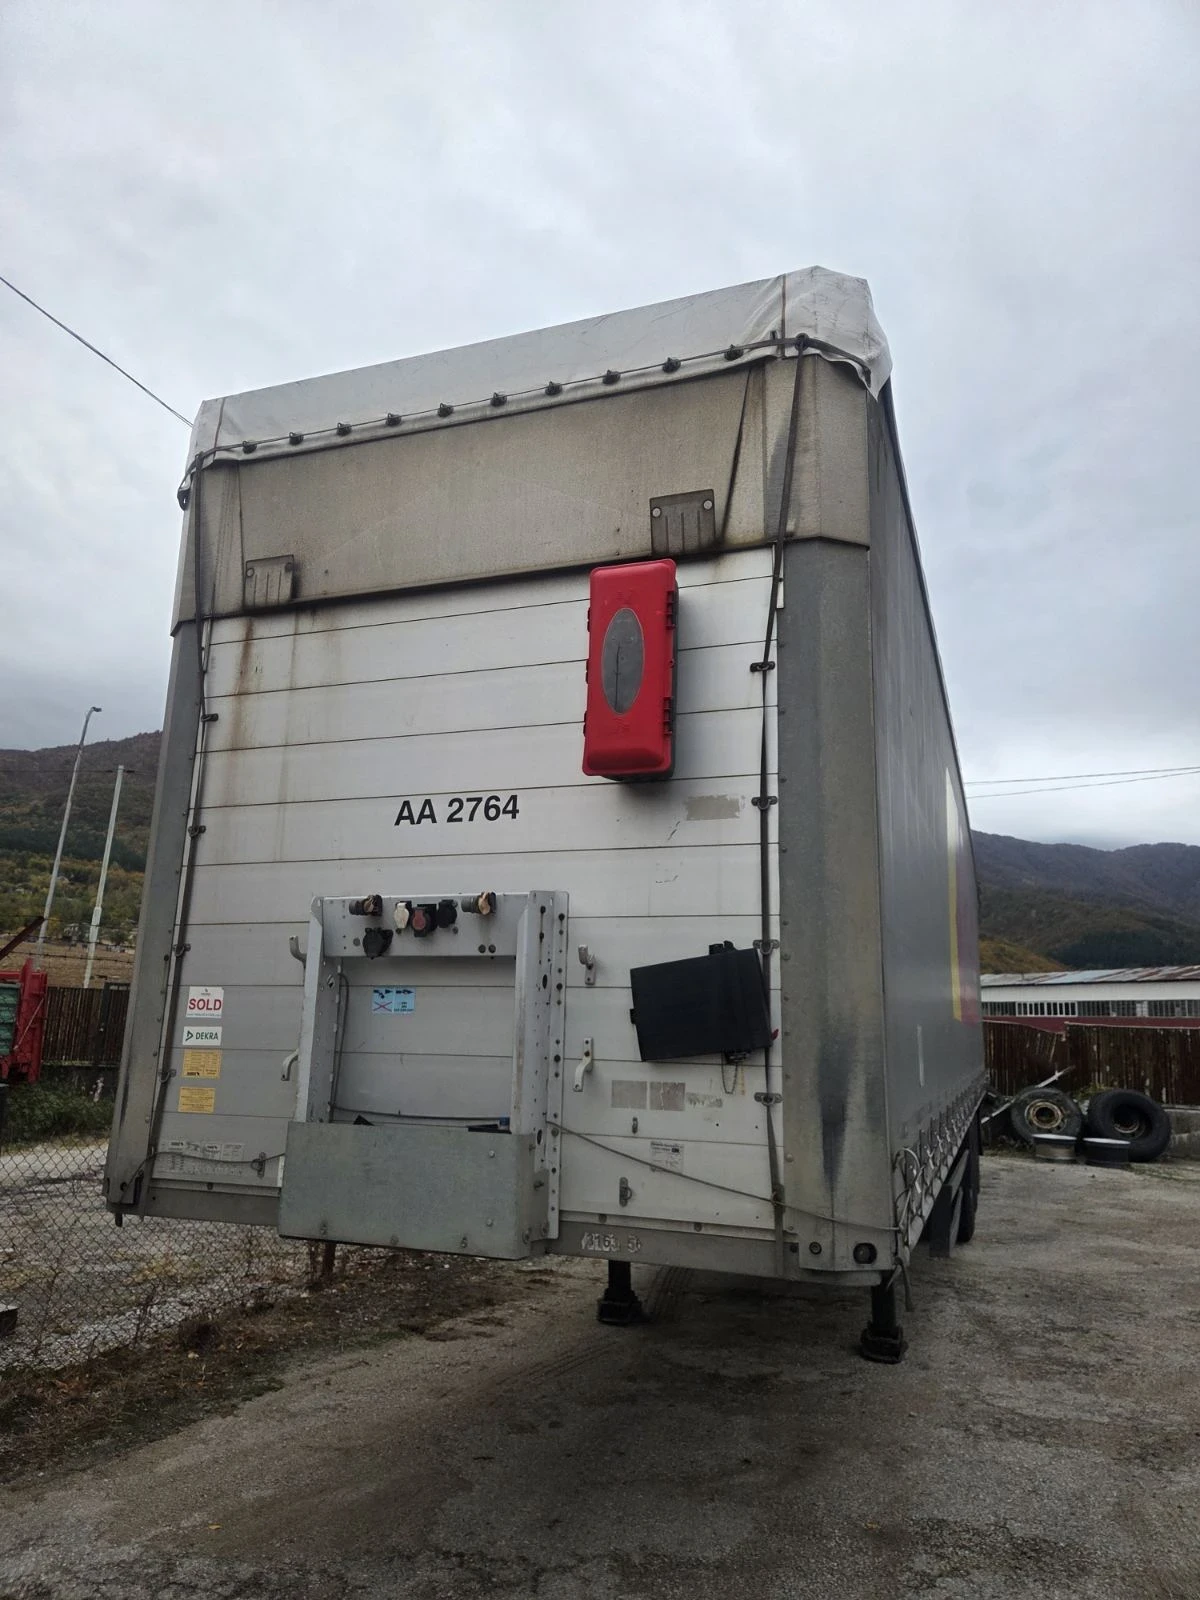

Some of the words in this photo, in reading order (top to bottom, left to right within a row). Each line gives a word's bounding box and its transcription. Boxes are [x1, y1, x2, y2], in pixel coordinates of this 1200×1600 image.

[394, 798, 437, 826] AA
[446, 794, 520, 823] 2764
[188, 998, 222, 1011] SOLD
[195, 1031, 219, 1041] DEKRA
